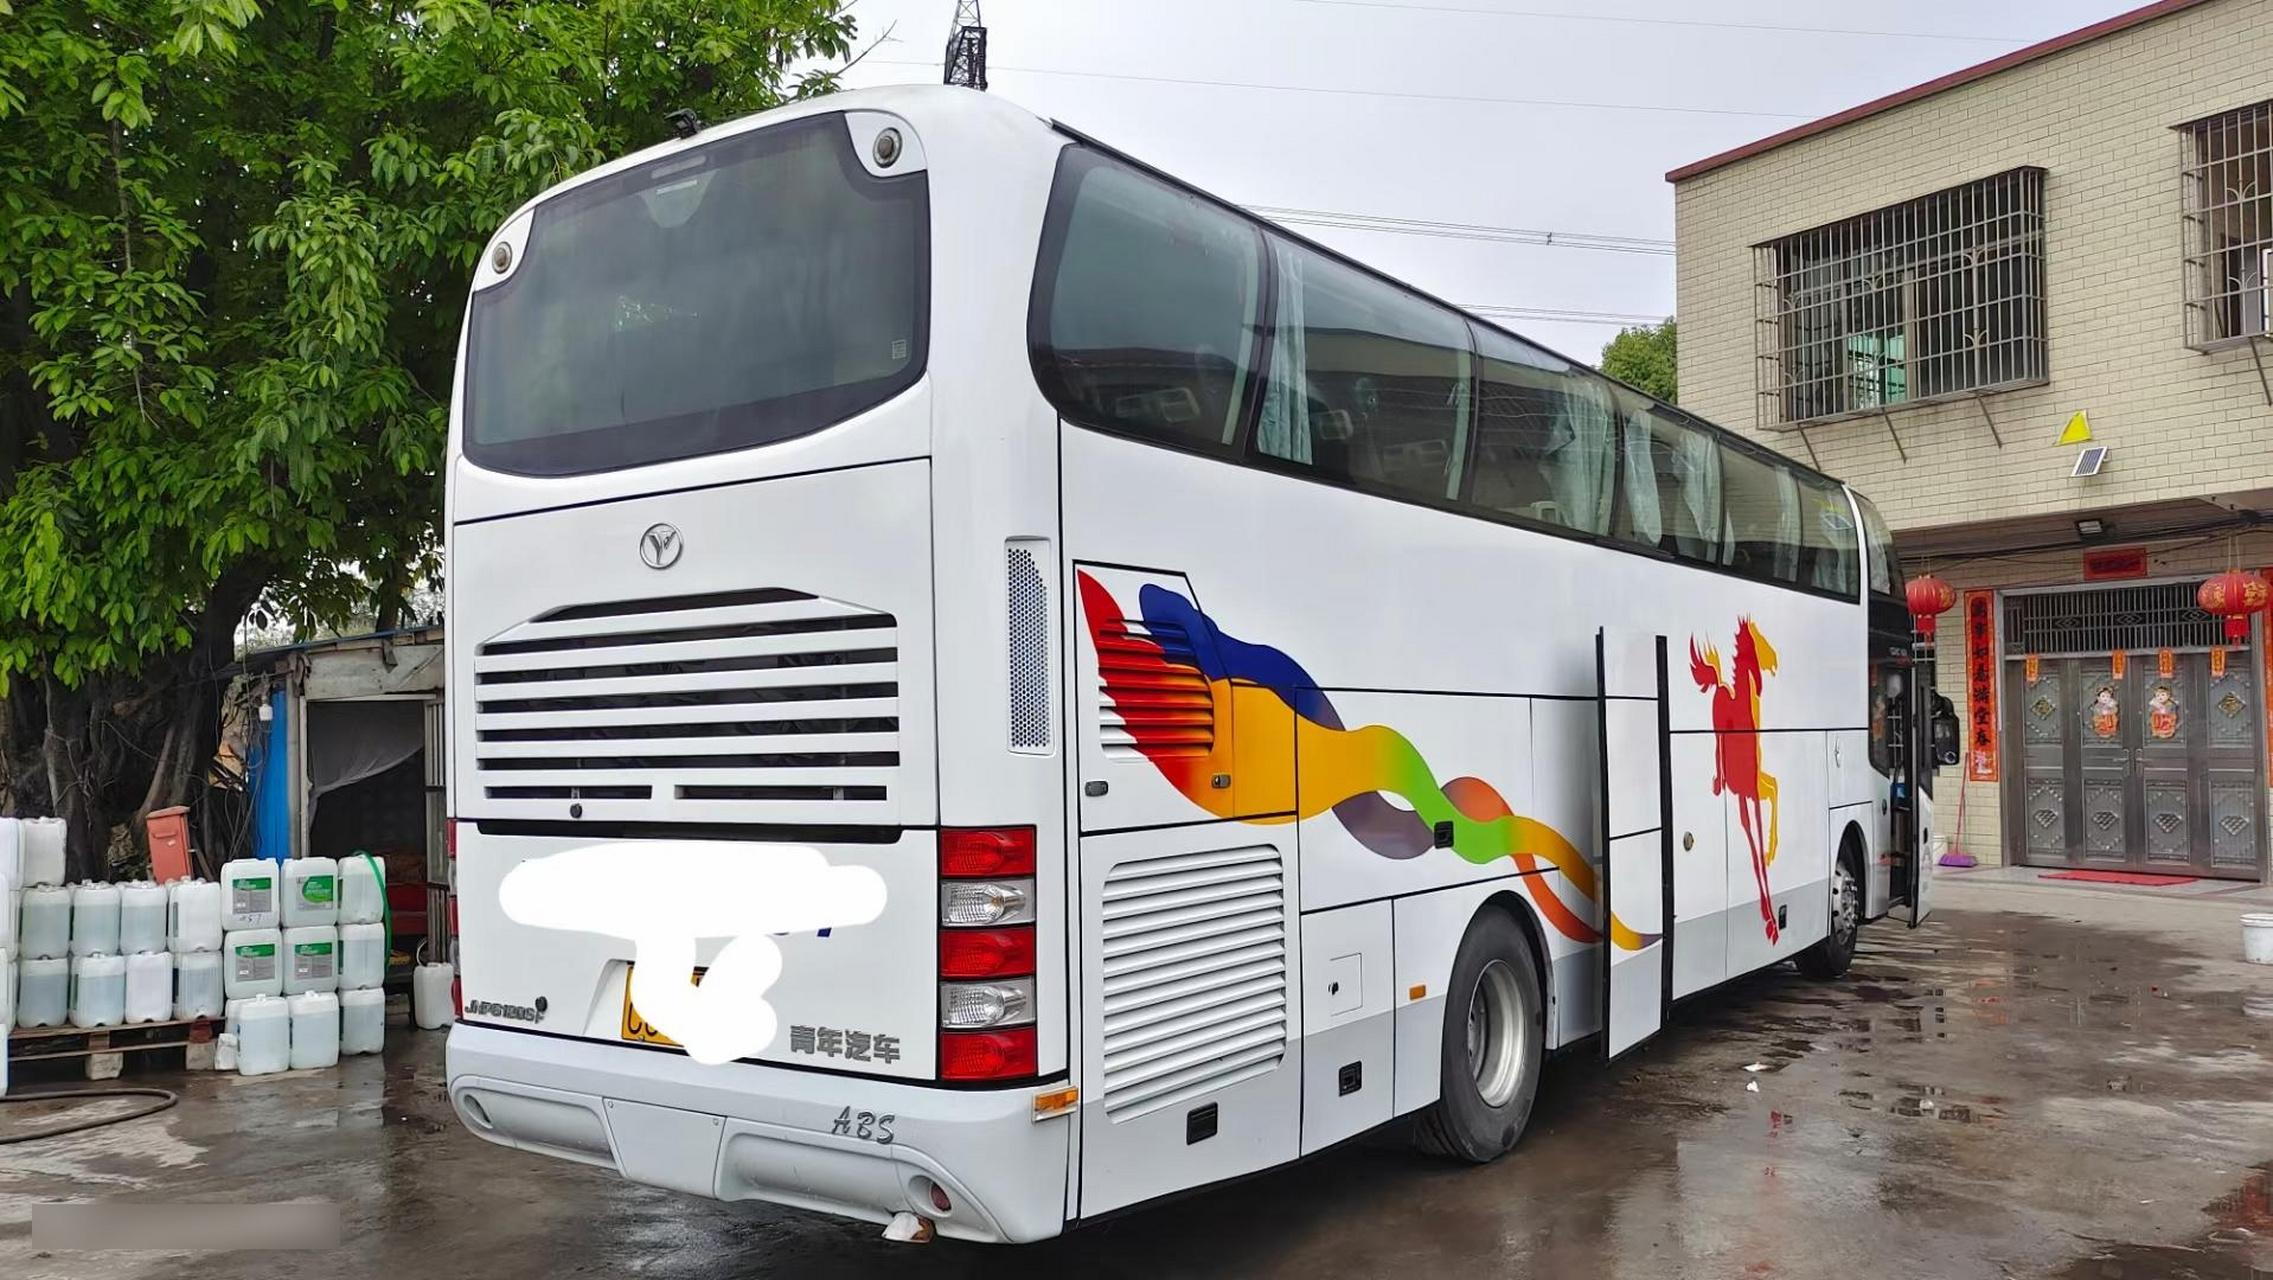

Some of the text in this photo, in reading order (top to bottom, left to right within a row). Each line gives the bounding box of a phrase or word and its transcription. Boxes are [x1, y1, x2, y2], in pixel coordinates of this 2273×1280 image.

[790, 1025, 901, 1064] 青年汽车
[832, 1106, 895, 1144] ABS
